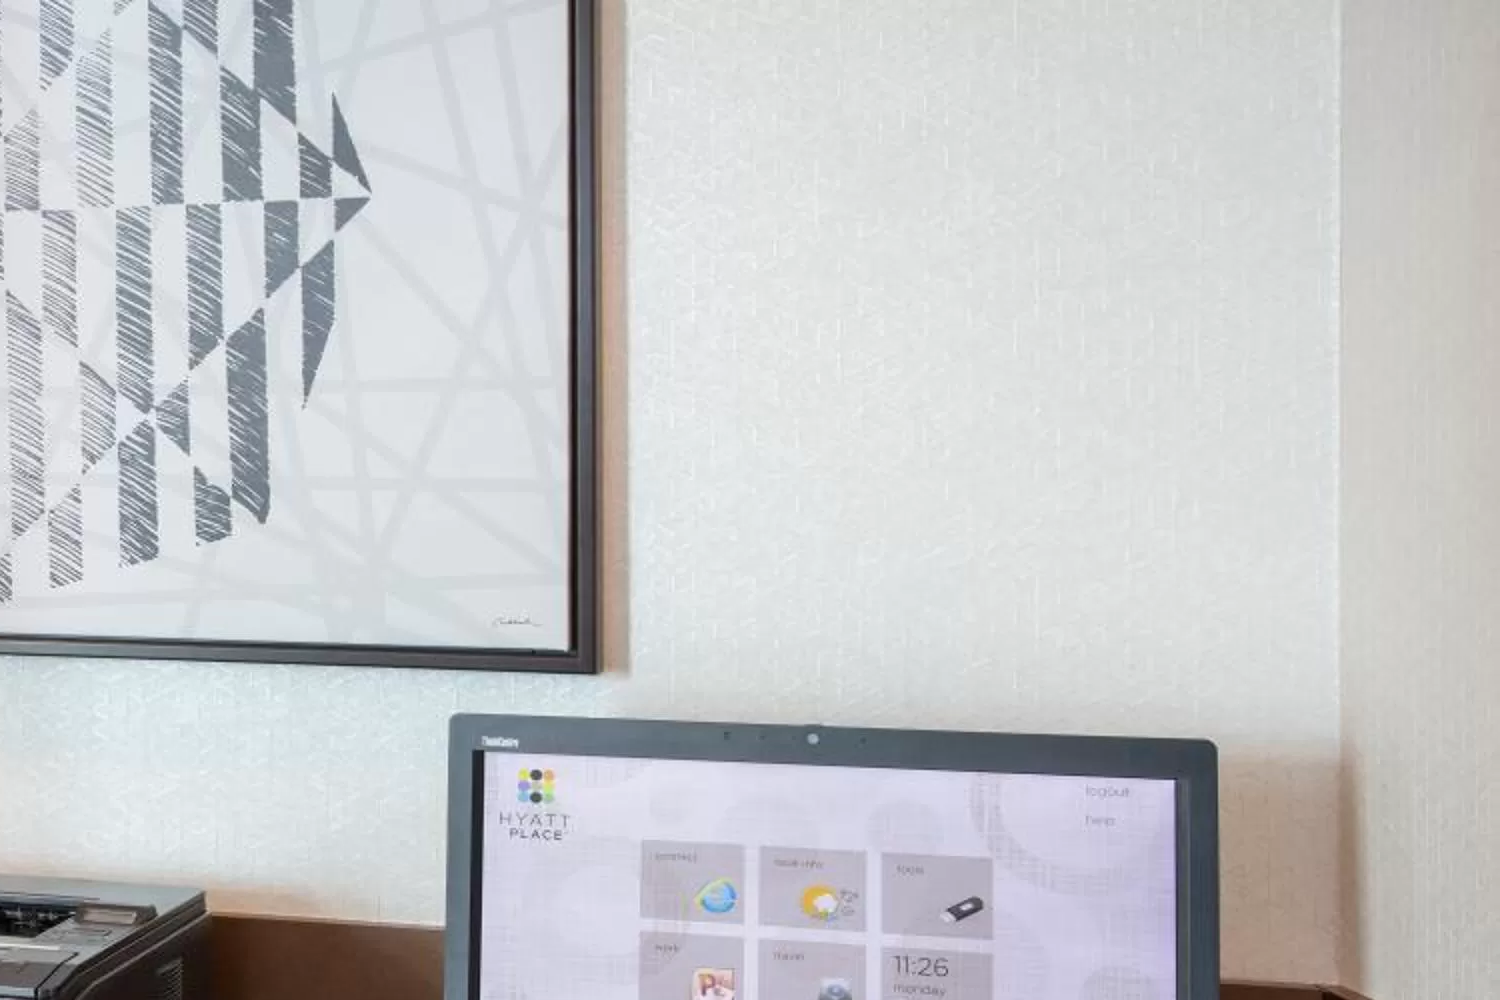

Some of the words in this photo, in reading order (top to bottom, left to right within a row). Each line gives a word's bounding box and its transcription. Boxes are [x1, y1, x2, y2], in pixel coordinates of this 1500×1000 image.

[499, 811, 570, 828] HYATT
[509, 827, 563, 841] PLACE
[892, 954, 949, 978] 11:26
[892, 983, 946, 998] monday
